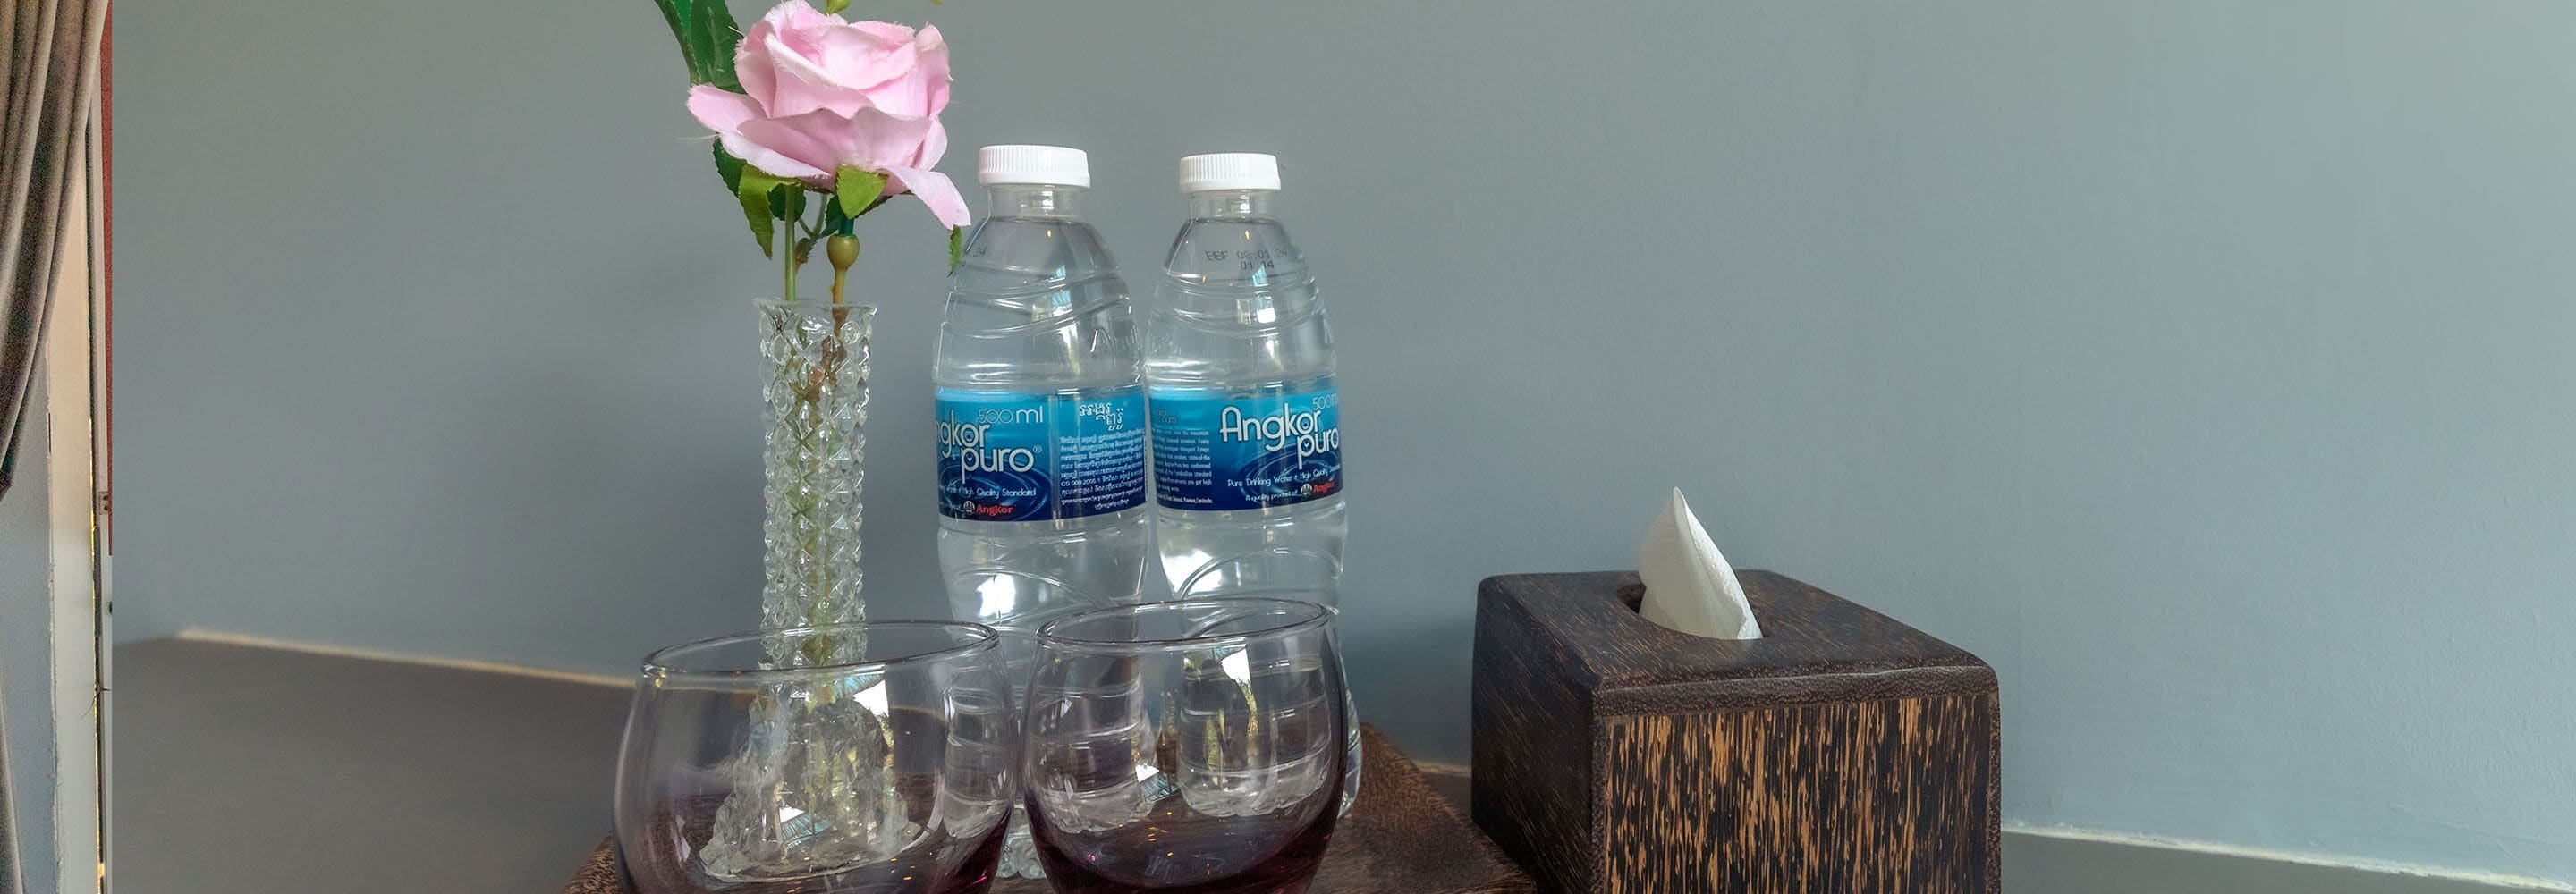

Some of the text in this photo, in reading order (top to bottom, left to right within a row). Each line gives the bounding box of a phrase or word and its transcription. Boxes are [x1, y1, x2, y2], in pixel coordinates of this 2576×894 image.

[1219, 403, 1321, 451] Angkor
[1297, 427, 1340, 469] puro
[961, 446, 1035, 485] puro
[976, 487, 999, 499] Quality
[1002, 487, 1037, 497] Standard
[1227, 479, 1243, 487] Pure
[1246, 477, 1272, 487] Drinking
[976, 503, 1014, 516] Angkor
